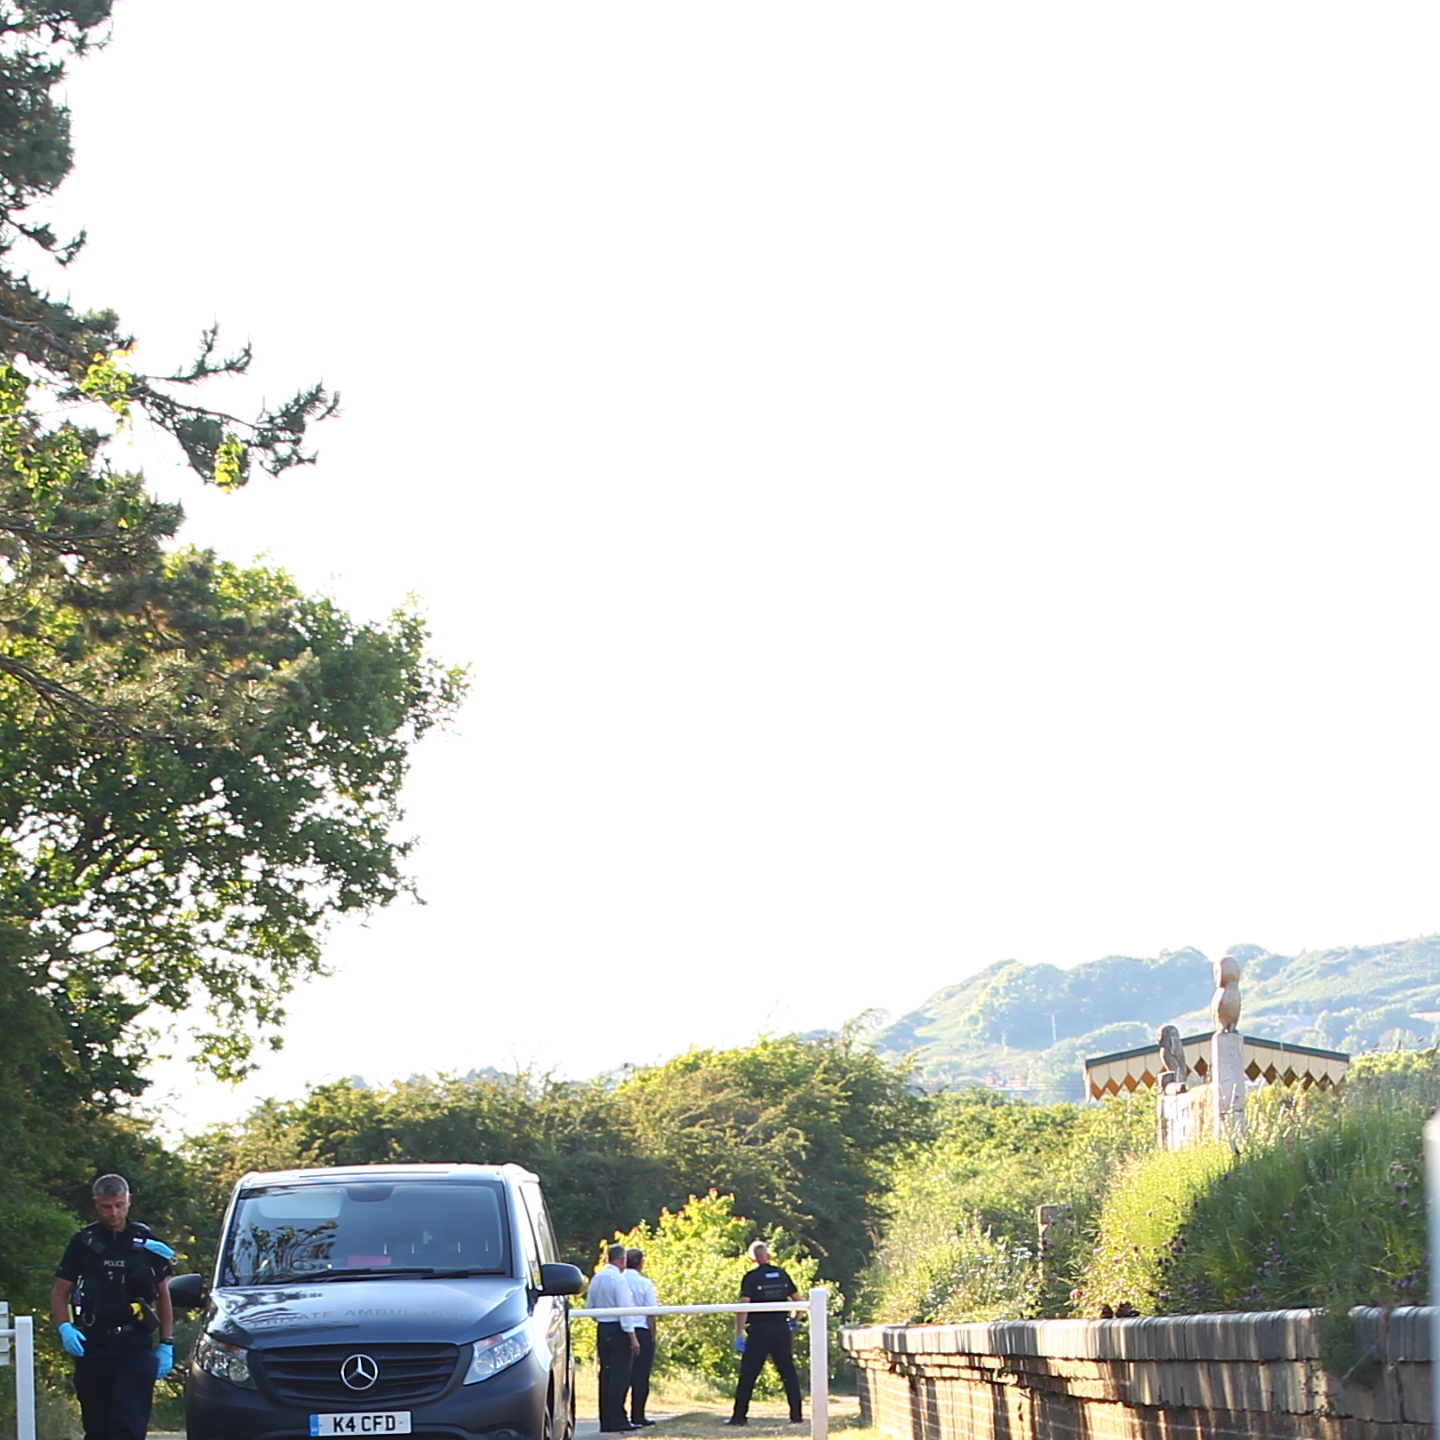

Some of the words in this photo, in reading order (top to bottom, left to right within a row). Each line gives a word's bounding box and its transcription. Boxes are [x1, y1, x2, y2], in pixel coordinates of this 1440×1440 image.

[103, 1259, 126, 1268] POLICE
[252, 1309, 334, 1328] PRIVATE
[344, 1307, 470, 1321] AMBULANCE
[333, 1416, 356, 1433] K4
[361, 1415, 396, 1432] CFD
